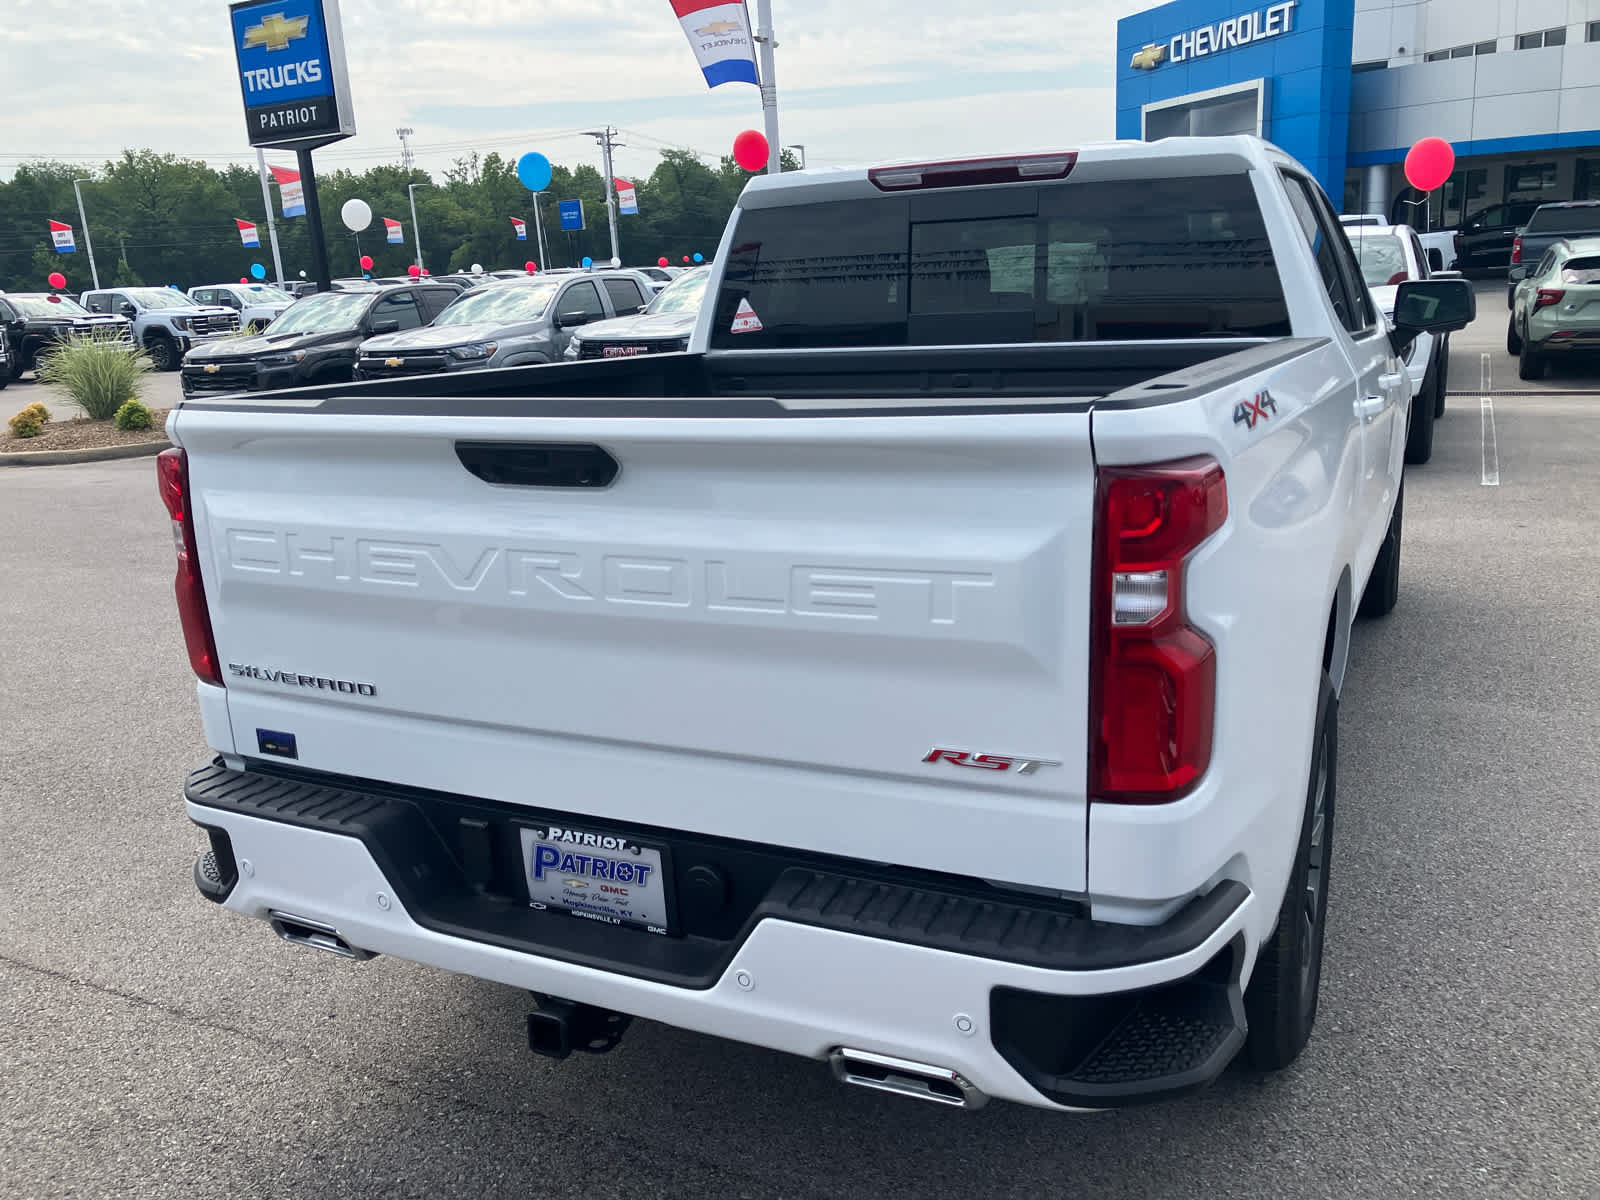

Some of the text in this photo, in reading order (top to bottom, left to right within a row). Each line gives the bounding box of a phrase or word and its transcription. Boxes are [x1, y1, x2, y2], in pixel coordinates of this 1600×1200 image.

[1170, 0, 1295, 63] CHEVROLET
[243, 59, 322, 92] TRUCKS
[260, 106, 317, 129] PATRIOT
[225, 528, 995, 625] CHEVROLET
[228, 662, 378, 698] SILVERADO
[921, 746, 1063, 775] RST
[548, 826, 627, 851] PATRIOT
[600, 884, 629, 897] GMC
[620, 909, 633, 918] KY
[647, 925, 667, 935] GMC
